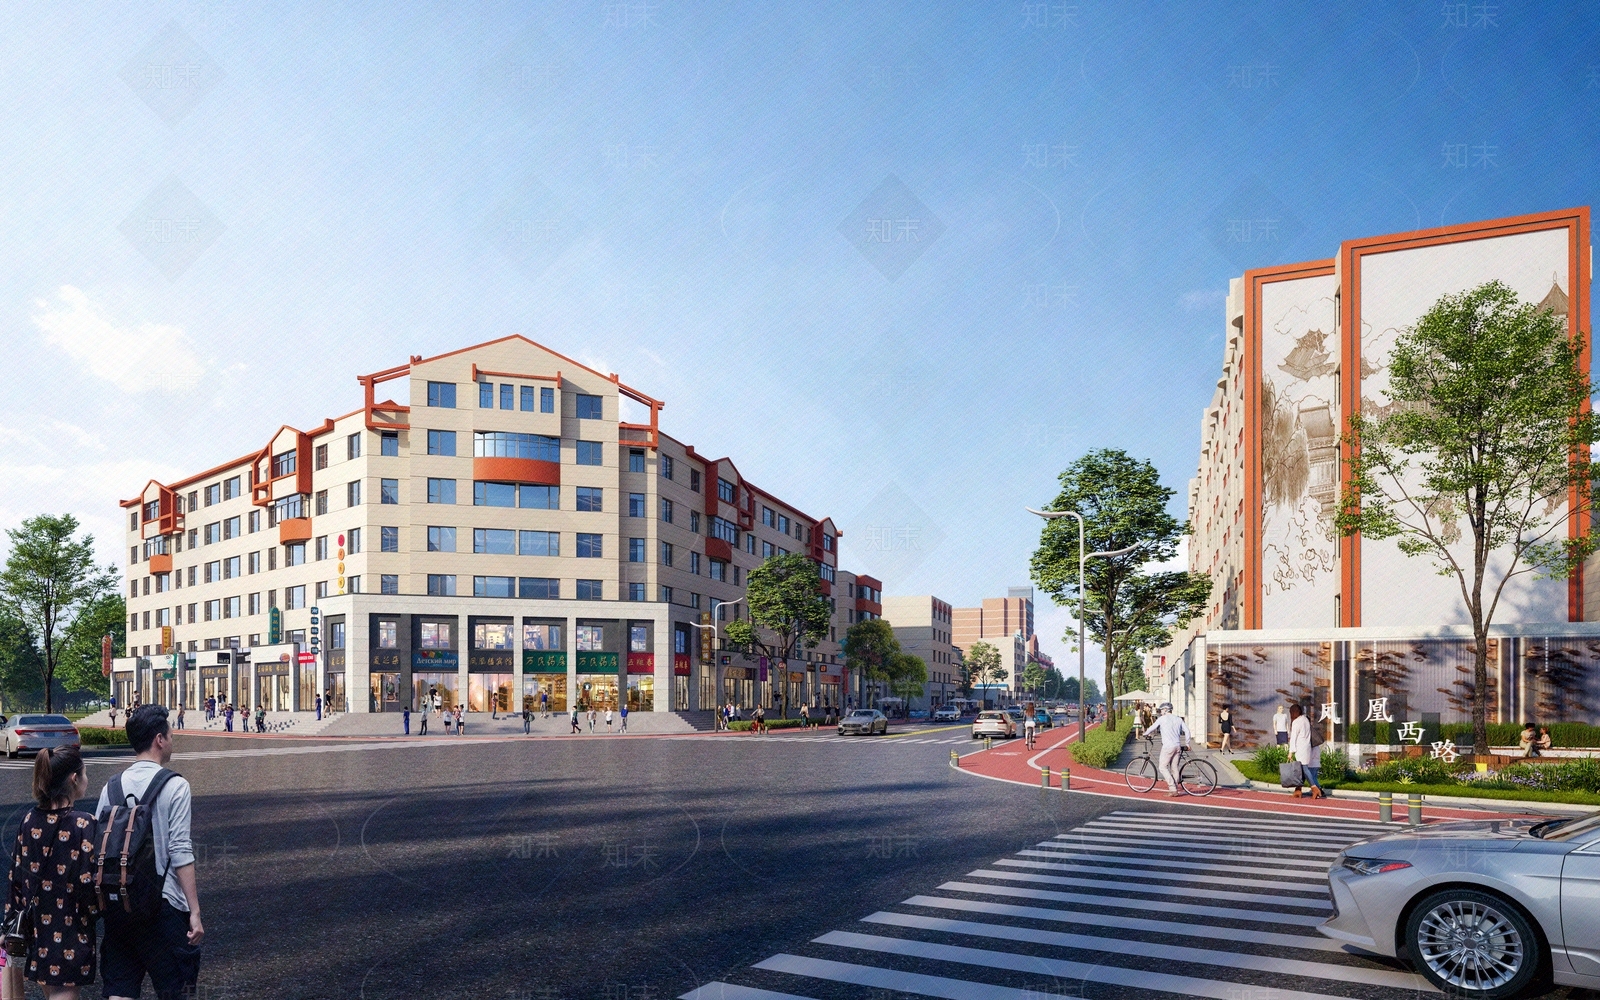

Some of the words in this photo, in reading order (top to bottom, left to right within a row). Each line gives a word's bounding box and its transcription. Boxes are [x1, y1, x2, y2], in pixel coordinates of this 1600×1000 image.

[416, 657, 443, 665] Детский
[443, 658, 457, 667] мир
[1318, 697, 1461, 763] 凤凰西路
